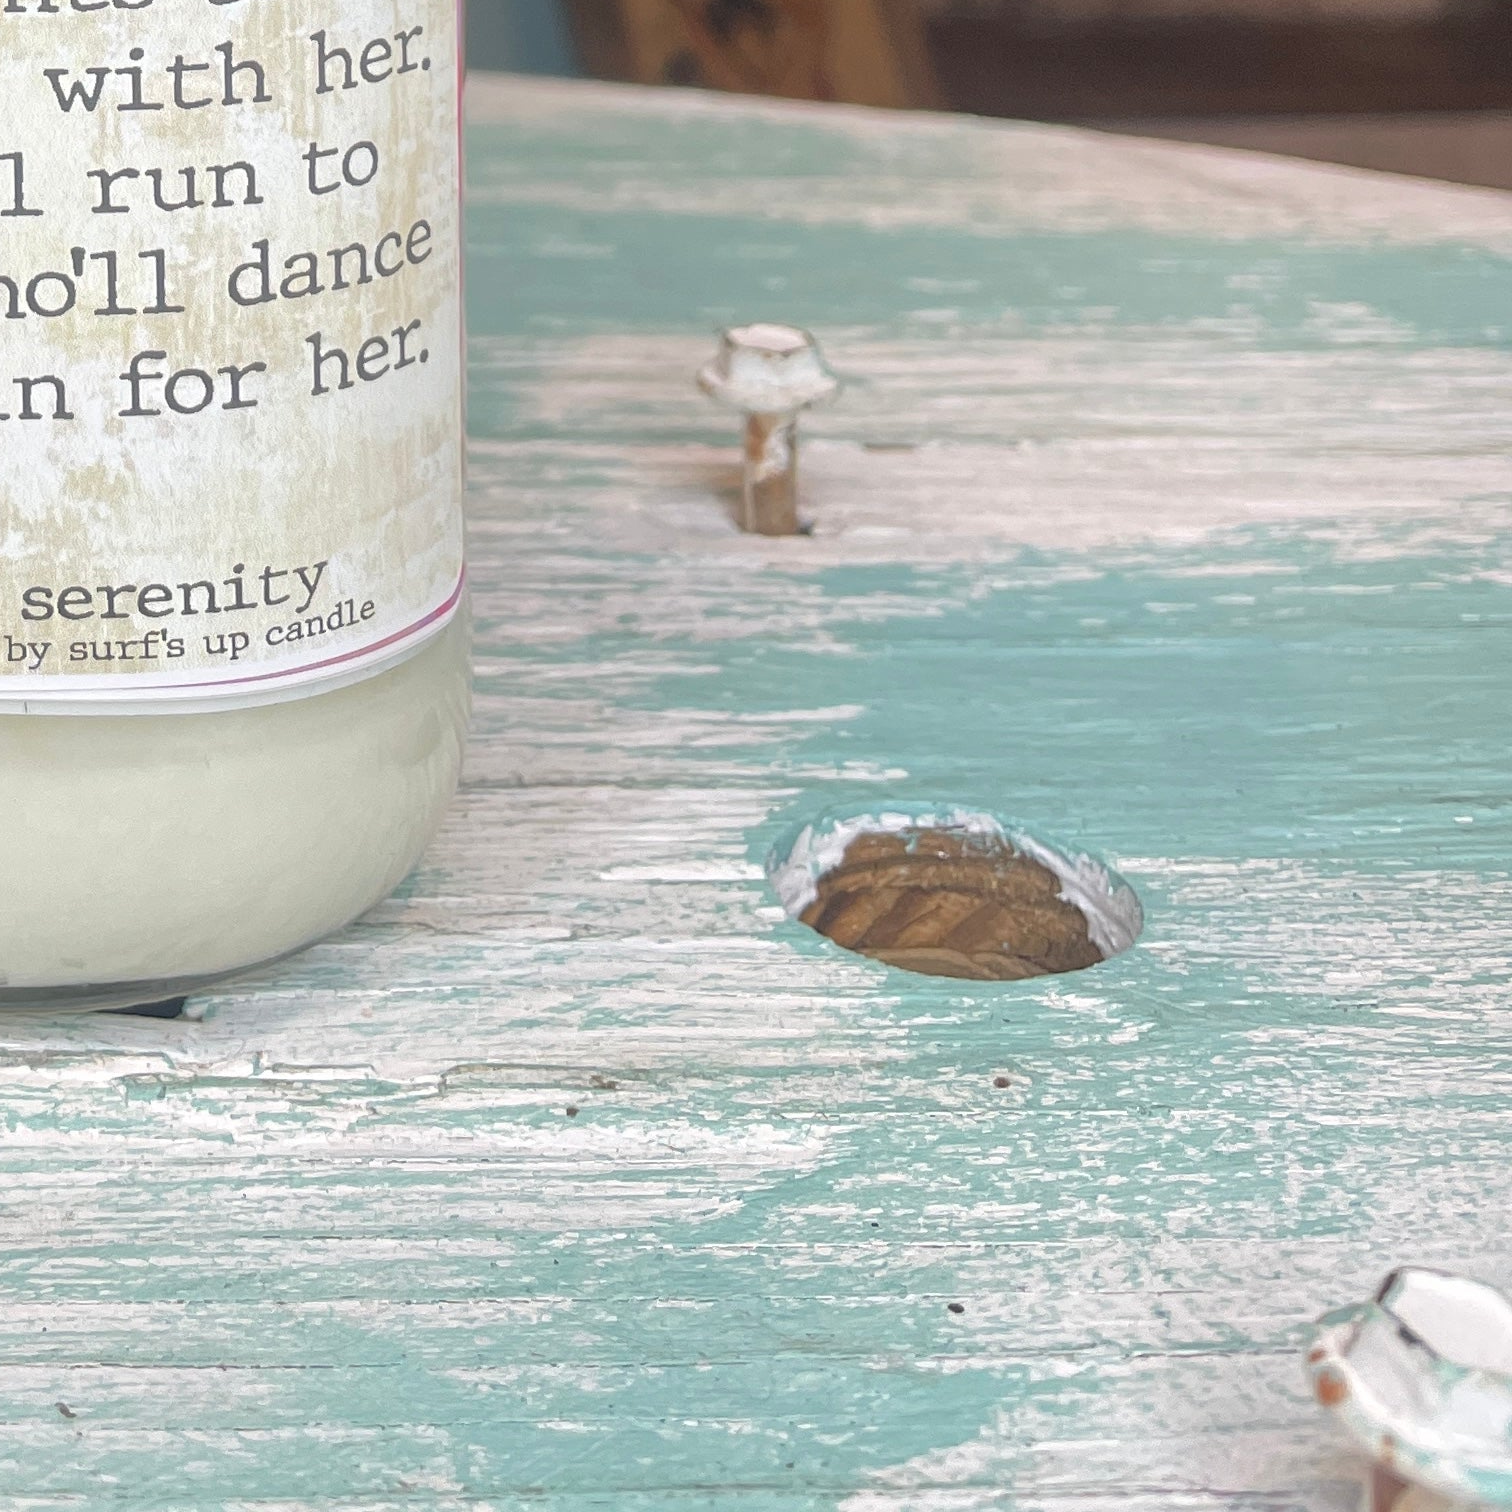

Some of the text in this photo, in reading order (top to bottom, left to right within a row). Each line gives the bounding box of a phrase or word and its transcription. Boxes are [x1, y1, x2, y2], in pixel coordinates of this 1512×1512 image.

[43, 43, 273, 113] with
[309, 25, 431, 95] her.
[86, 161, 264, 214] run
[302, 141, 379, 195] to
[228, 219, 433, 306] dance
[118, 350, 267, 417] for
[305, 319, 429, 396] her.
[3, 635, 52, 670] by
[69, 628, 185, 661] surf's
[202, 632, 250, 661] up
[263, 593, 375, 646] candle
[21, 561, 328, 625] serenity
